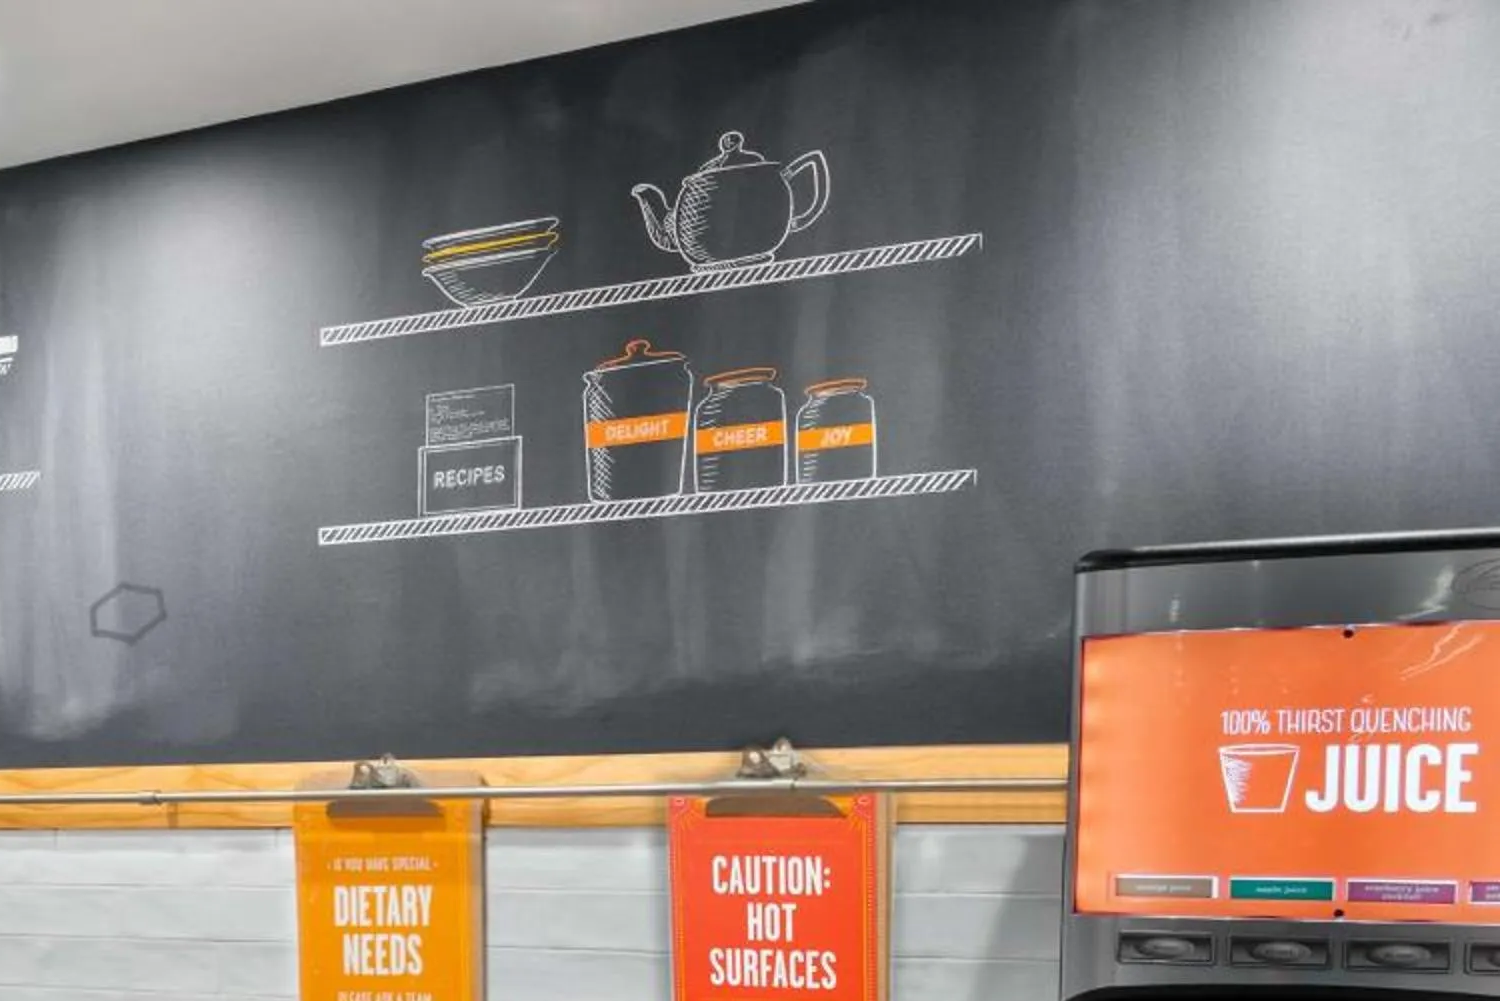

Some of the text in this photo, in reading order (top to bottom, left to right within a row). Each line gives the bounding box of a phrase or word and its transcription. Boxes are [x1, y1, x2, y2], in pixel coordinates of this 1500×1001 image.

[604, 419, 672, 440] DELIGHT
[713, 427, 769, 448] CHEER
[820, 427, 853, 446] JOY
[433, 464, 505, 490] RECIPES
[1220, 706, 1473, 735] 100% THIRST QUENCHING
[1305, 743, 1479, 812] JUICE
[393, 857, 433, 872] SPECIAL
[712, 855, 831, 896] CAUTION:
[333, 885, 433, 927] DIETARY
[747, 902, 797, 942] HOT
[343, 933, 424, 976] NEEDS
[709, 948, 837, 989] SURFACES
